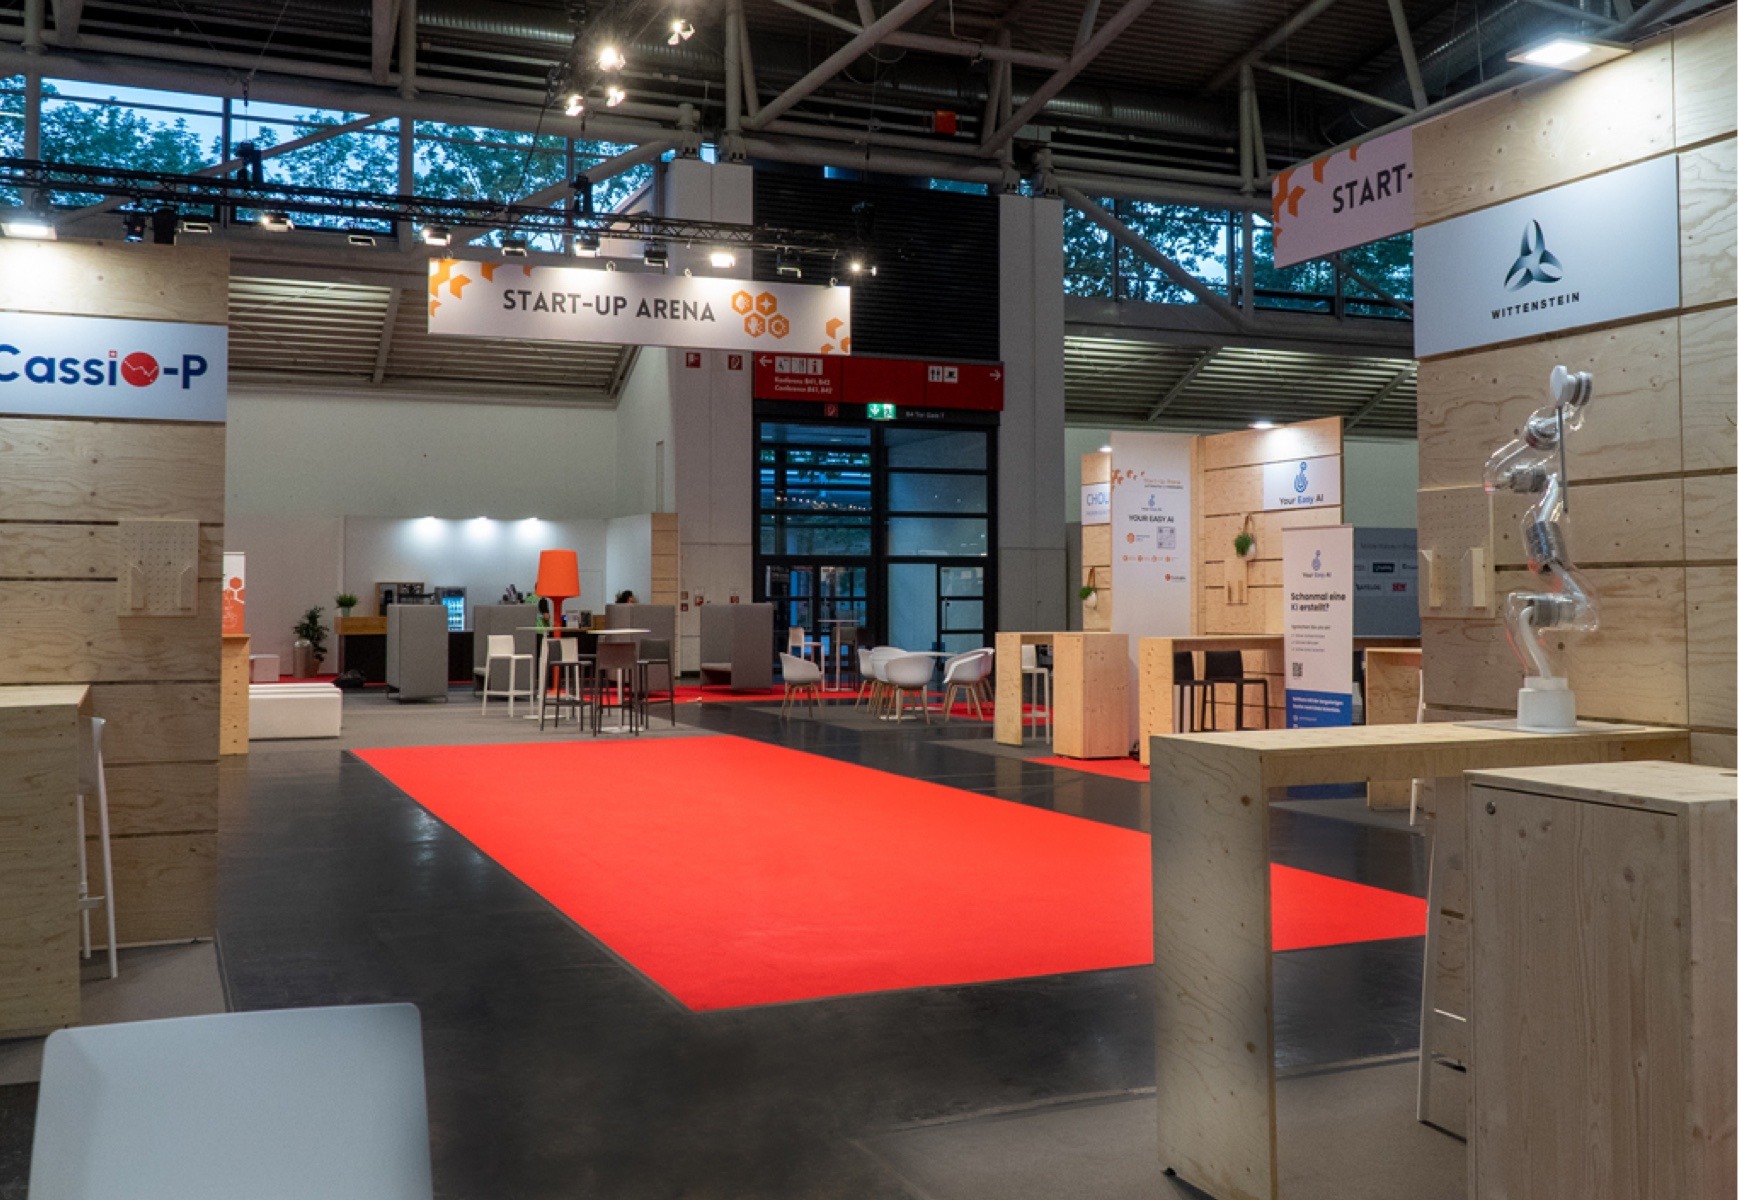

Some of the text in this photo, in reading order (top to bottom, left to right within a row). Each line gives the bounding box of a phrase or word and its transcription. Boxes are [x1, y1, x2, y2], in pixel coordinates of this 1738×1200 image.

[503, 289, 716, 322] START-UP ARENA
[1491, 291, 1580, 320] WITTENSTEIN
[1279, 494, 1324, 505] Your Easy AI
[1128, 514, 1149, 522] YOUR
[1149, 515, 1166, 523] EASY
[1290, 592, 1346, 601] Schonmal eine
[1299, 602, 1330, 612] erstellt?
